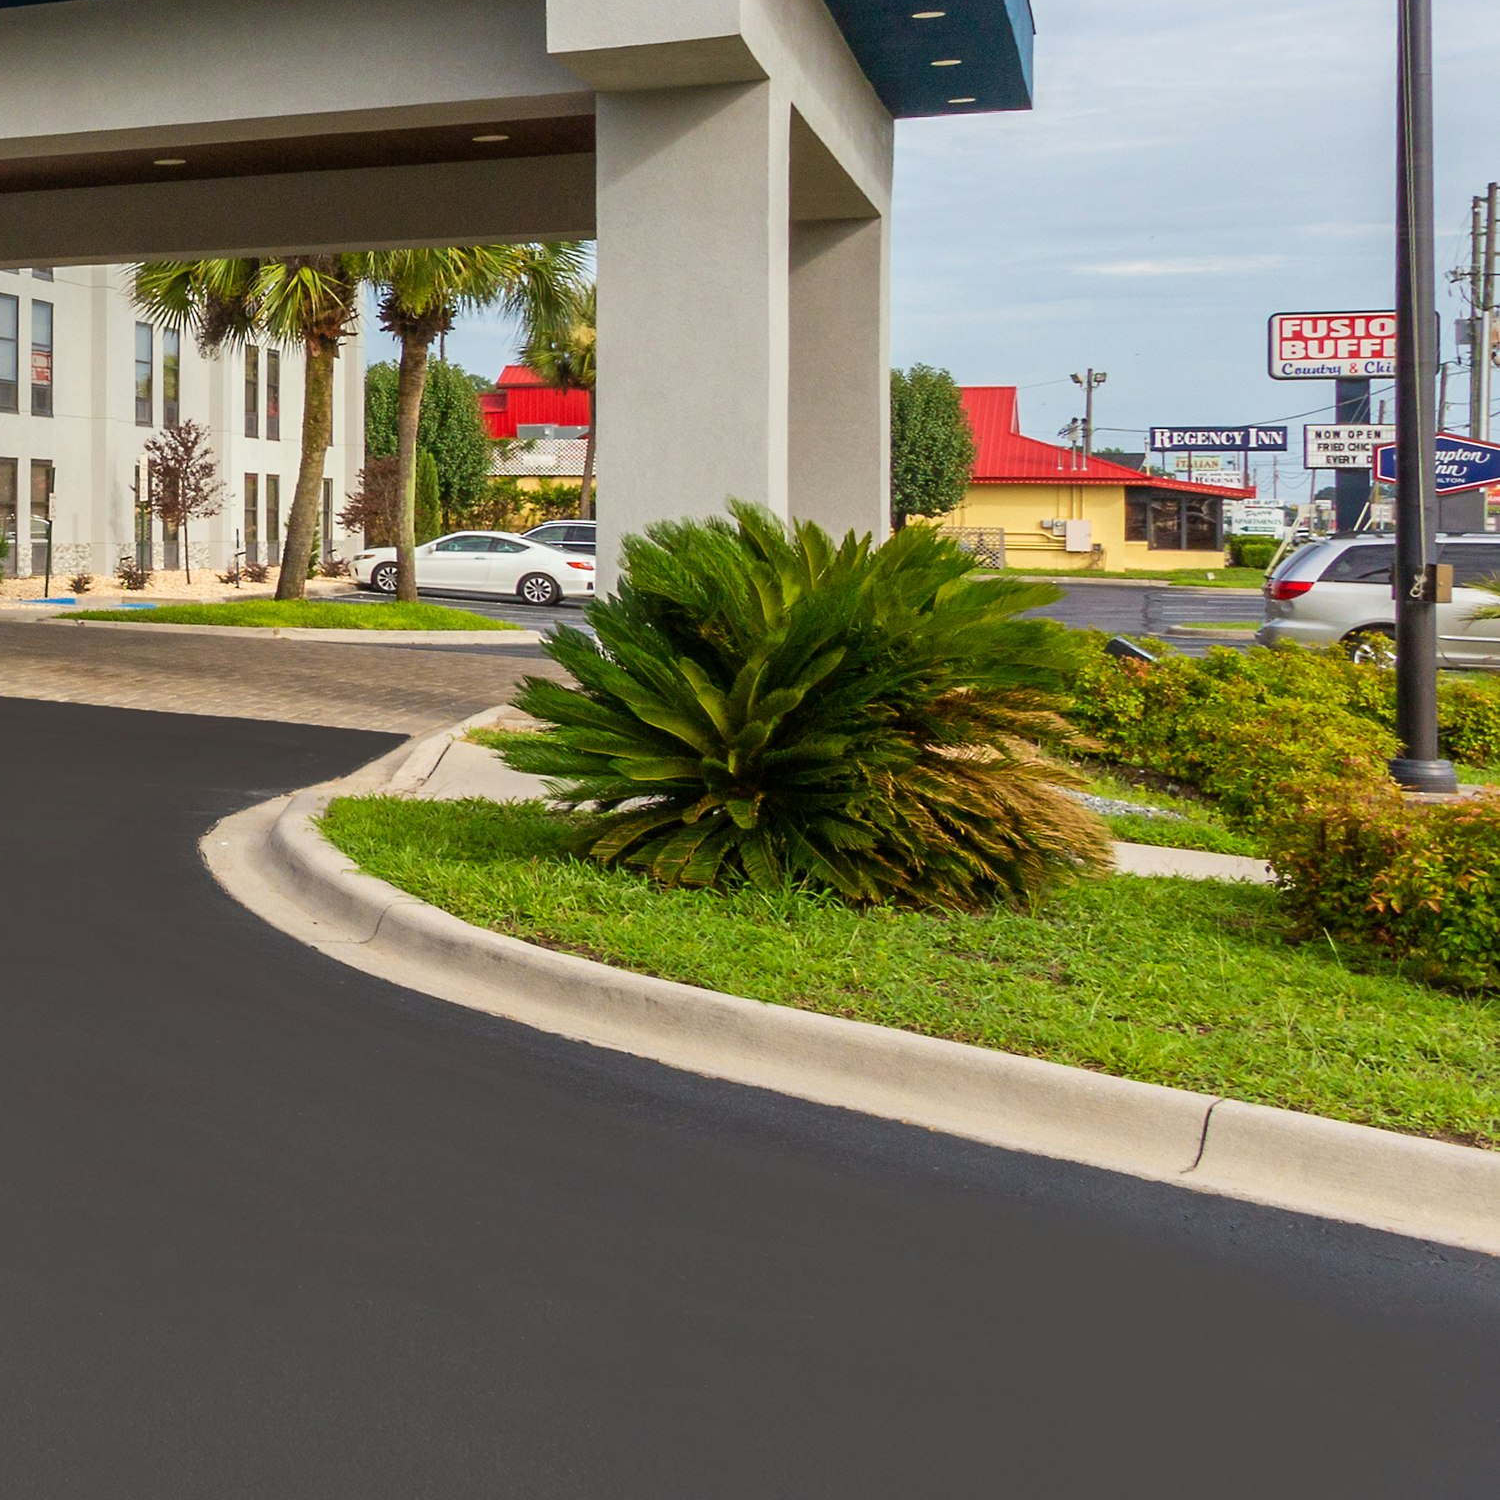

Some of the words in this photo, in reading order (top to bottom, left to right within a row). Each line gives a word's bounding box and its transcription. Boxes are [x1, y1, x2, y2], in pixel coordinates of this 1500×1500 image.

[1281, 317, 1396, 338] FUSIO
[1281, 363, 1342, 375] Country
[1349, 363, 1358, 374] &
[1153, 429, 1244, 448] REGENCY
[1248, 428, 1283, 447] INN
[1315, 431, 1340, 439] NOW
[1347, 430, 1381, 439] OPEN
[1317, 443, 1345, 451] FRIED
[1326, 455, 1357, 464] EVERY
